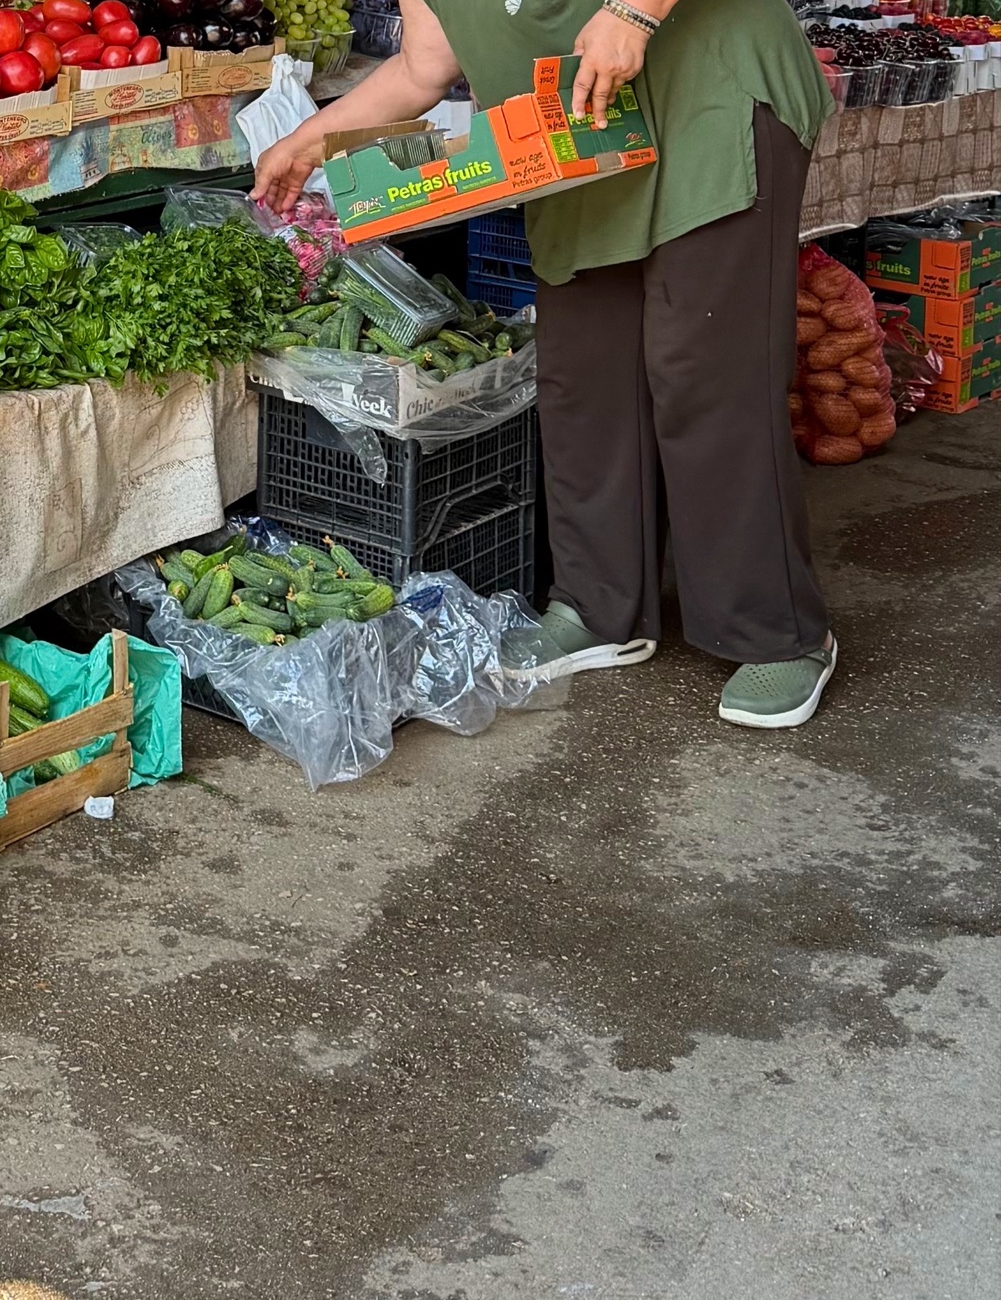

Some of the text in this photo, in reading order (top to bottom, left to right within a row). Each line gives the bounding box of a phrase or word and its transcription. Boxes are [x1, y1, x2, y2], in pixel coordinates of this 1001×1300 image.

[509, 151, 543, 167] new age
[523, 162, 546, 179] fruits
[386, 174, 443, 203] Petras
[445, 160, 493, 185] fruits
[876, 260, 911, 275] fruits
[406, 399, 434, 420] Chic
